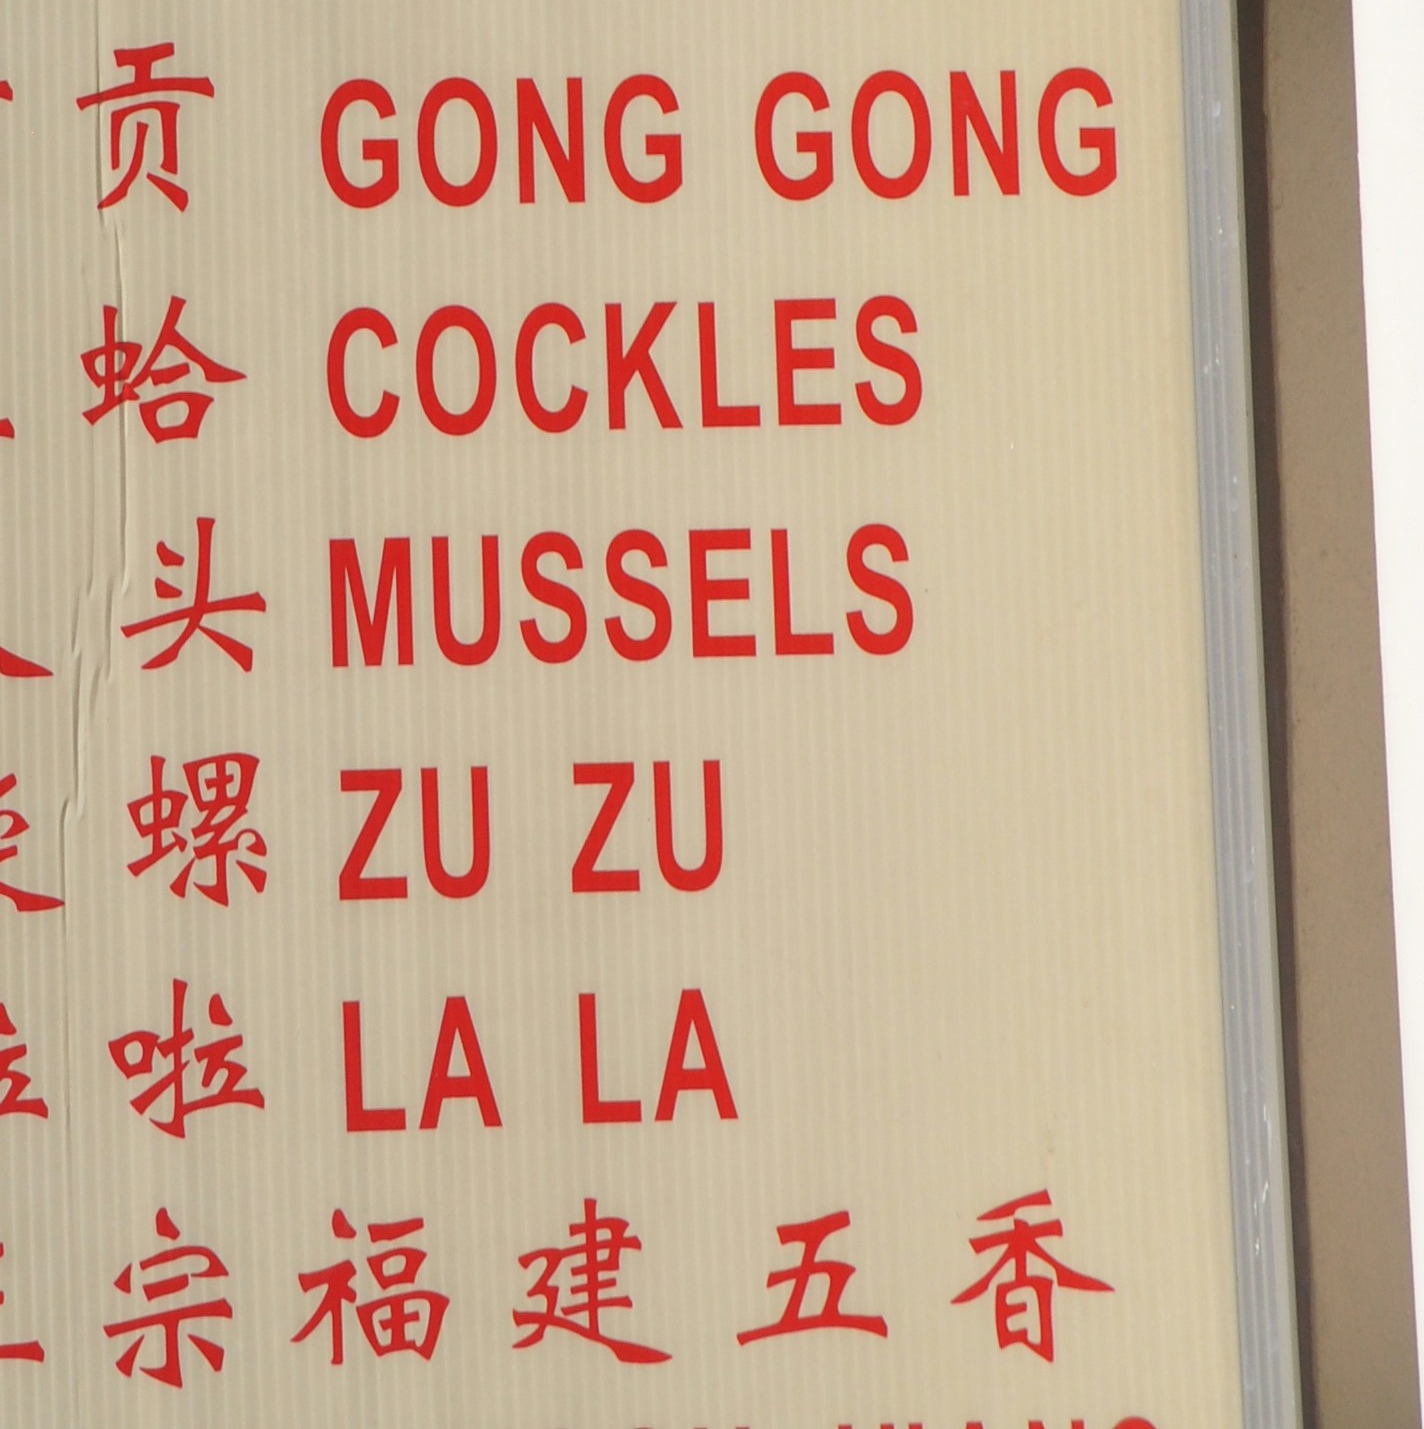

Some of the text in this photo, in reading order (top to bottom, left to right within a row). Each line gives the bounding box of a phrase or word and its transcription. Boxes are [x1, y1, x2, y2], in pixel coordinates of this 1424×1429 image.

[319, 66, 1119, 212] GONG GONG
[325, 293, 924, 441] COCKLES
[327, 522, 916, 670] MUSSELS
[337, 758, 725, 903] ZU ZU
[340, 987, 740, 1135] LA LA
